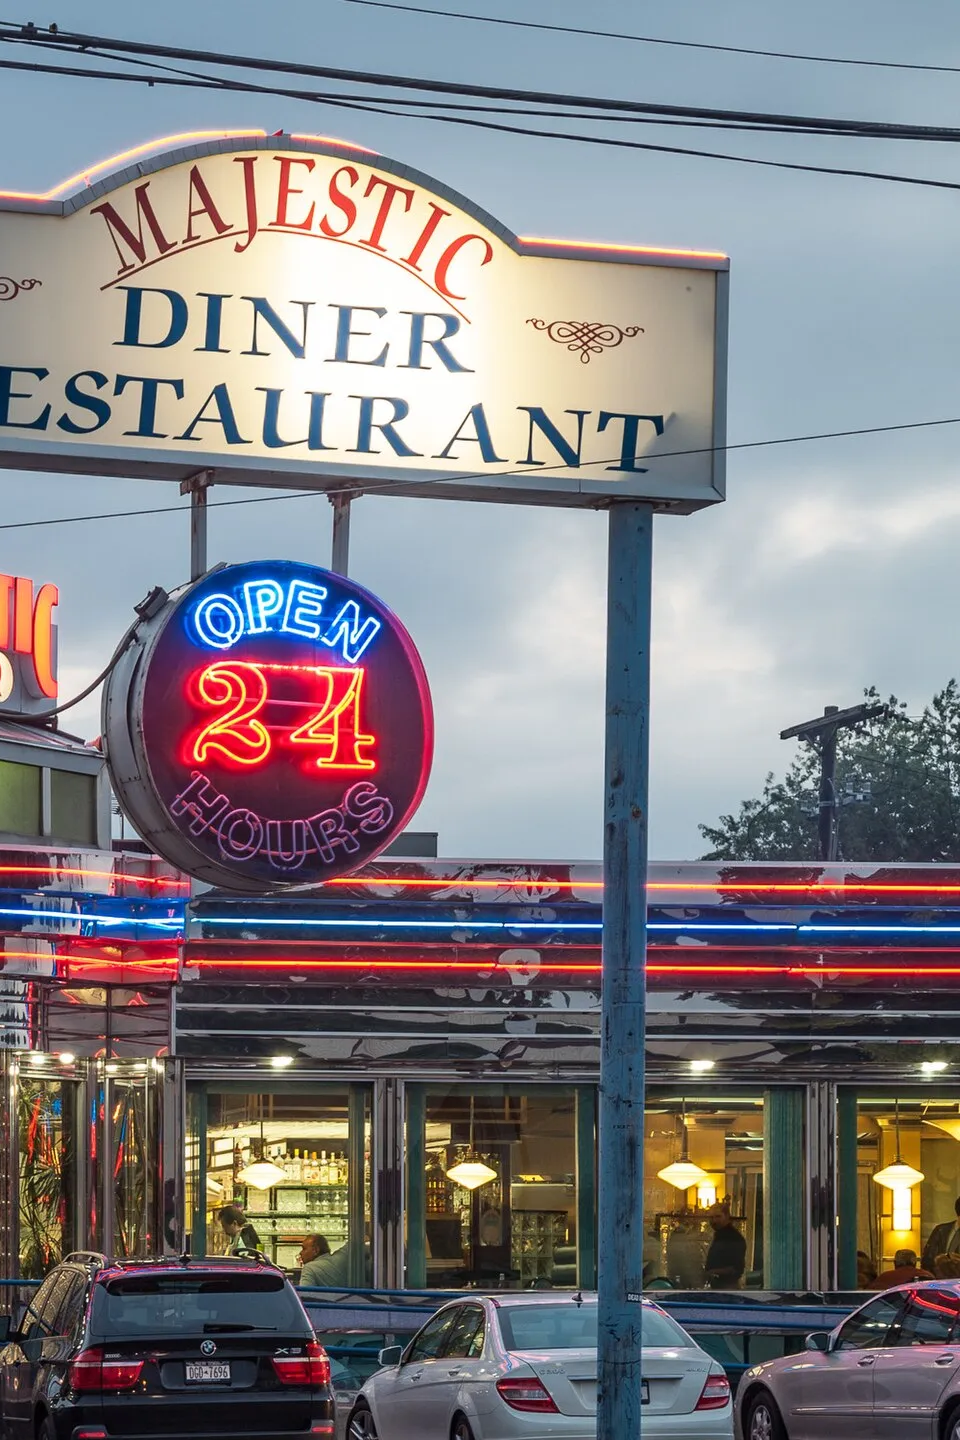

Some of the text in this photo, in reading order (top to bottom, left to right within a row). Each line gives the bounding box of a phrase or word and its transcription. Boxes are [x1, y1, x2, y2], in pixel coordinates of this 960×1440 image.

[89, 154, 495, 302] MAJESTIC
[113, 285, 476, 374] DINER
[194, 579, 381, 664] OPEN
[193, 660, 376, 770] 24
[170, 770, 394, 870] HOURS
